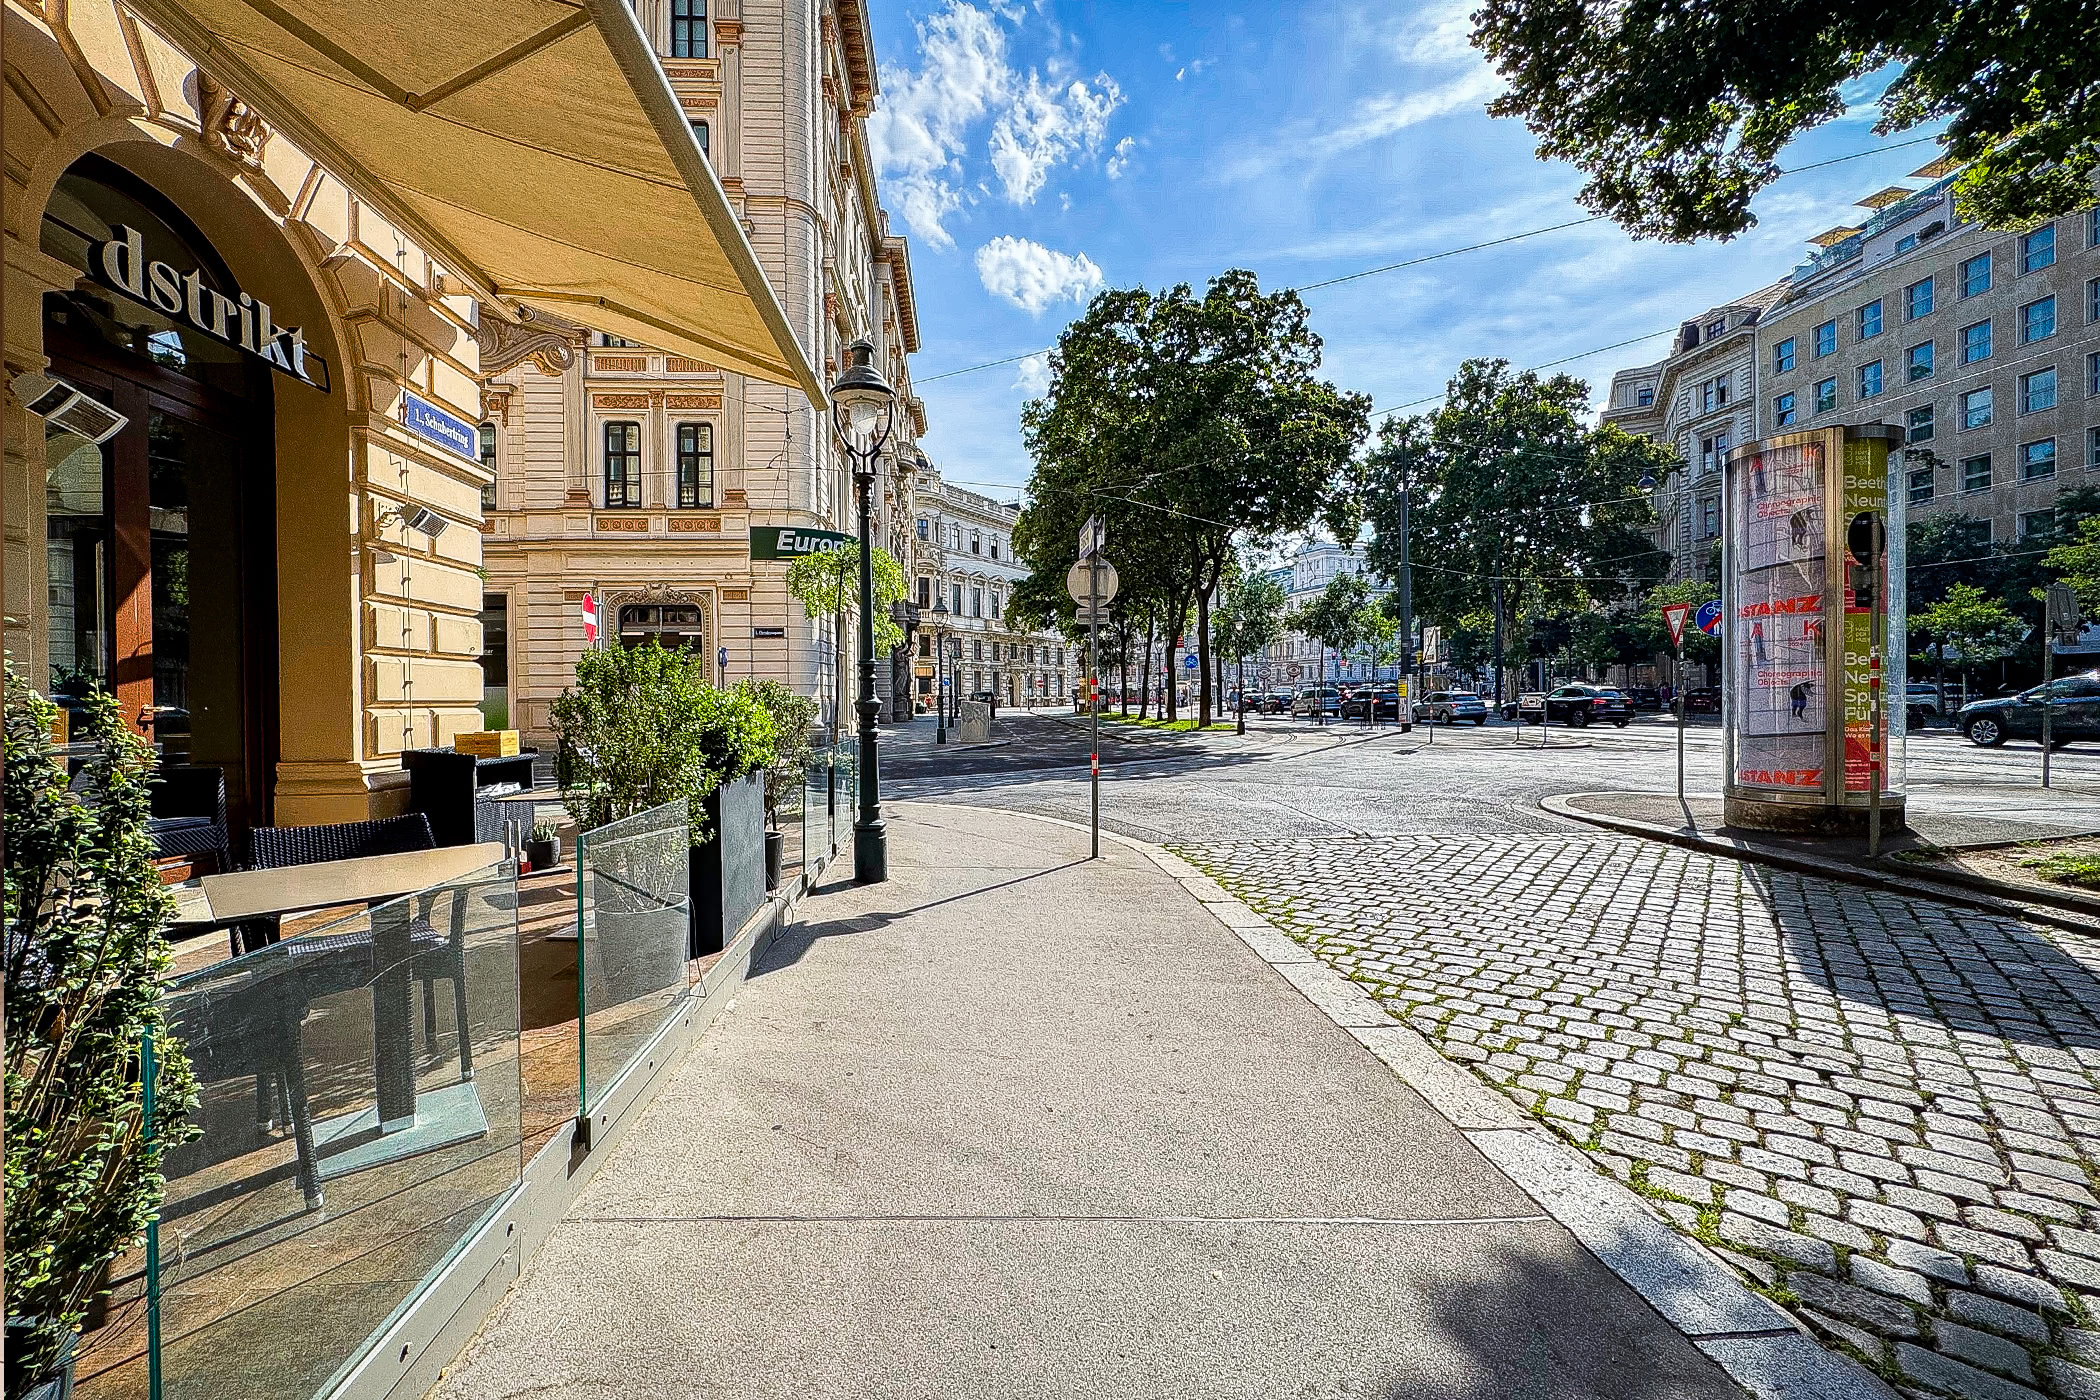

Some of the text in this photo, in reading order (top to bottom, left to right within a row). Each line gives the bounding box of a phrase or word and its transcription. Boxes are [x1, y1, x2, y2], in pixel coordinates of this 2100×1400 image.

[103, 224, 310, 380] dstrikt
[424, 412, 469, 449] Schubertring
[1757, 669, 1823, 679] Choreographic
